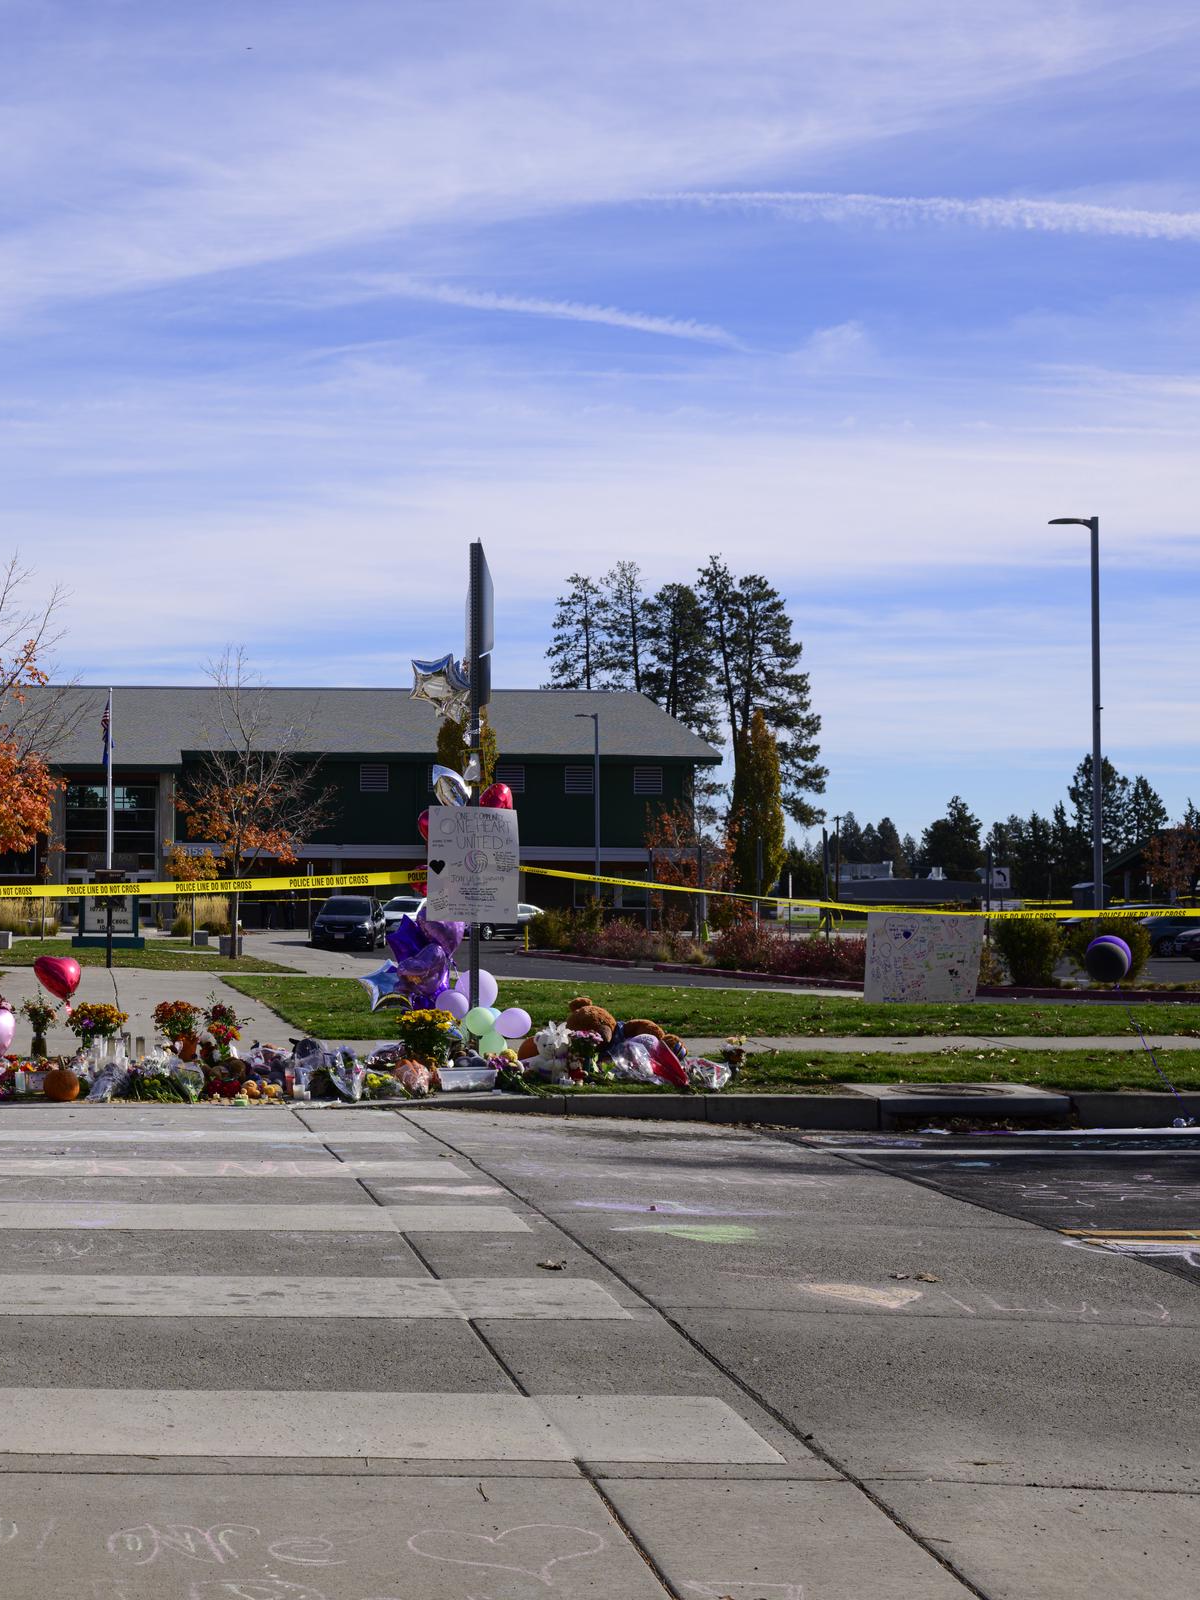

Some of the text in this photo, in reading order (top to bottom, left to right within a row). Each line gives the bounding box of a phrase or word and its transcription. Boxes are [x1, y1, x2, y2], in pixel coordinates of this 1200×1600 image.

[440, 817, 512, 835] ONE HEART
[456, 833, 504, 850] UNITED
[176, 881, 252, 892] POLICE LINE DO NOT CROSS
[289, 875, 369, 888] POLICE LINE DO NOT CROSS
[3, 887, 14, 896] NOT
[14, 887, 33, 895] CROSS
[66, 884, 140, 895] POLICE LINE DO NOT CROSS
